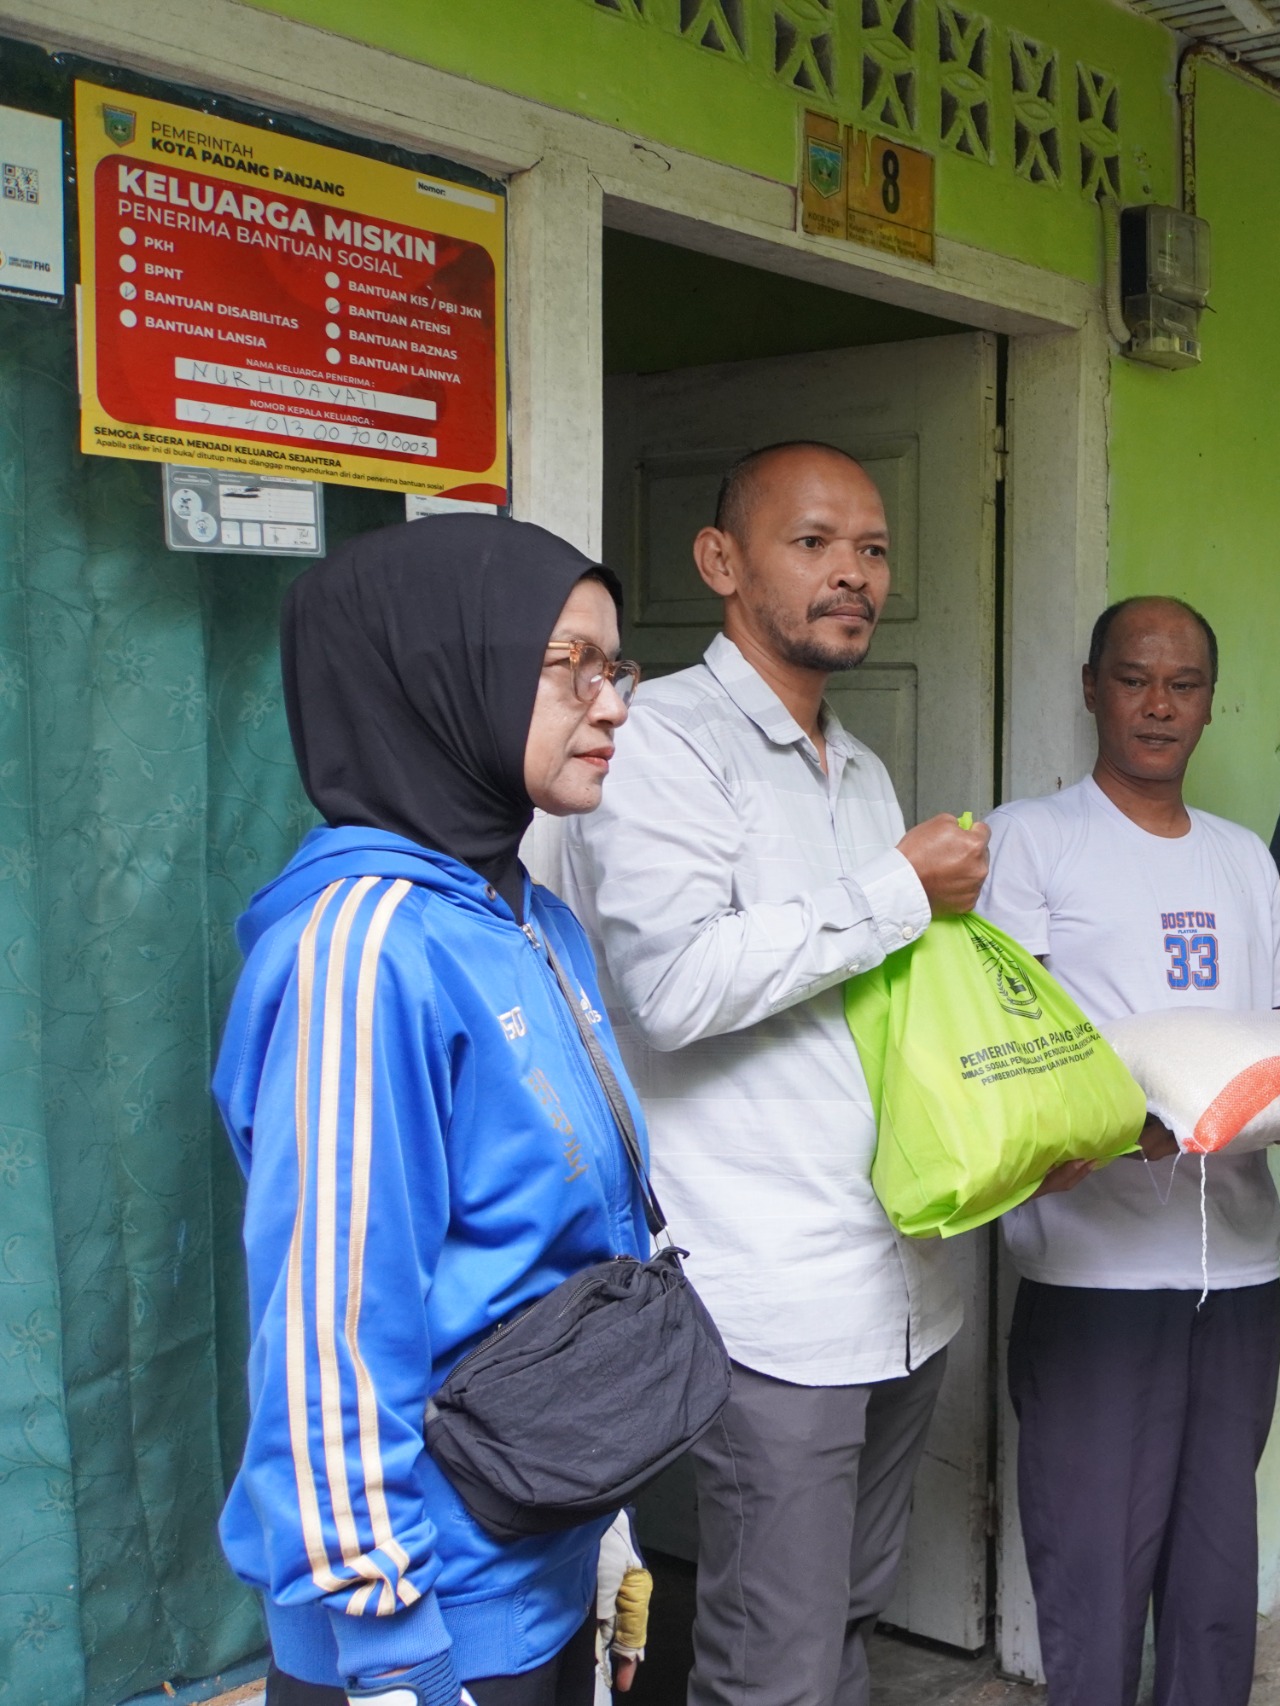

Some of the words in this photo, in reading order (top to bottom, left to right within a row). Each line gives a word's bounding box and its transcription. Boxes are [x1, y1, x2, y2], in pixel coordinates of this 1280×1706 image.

[151, 121, 253, 159] PEMERINTAH
[151, 137, 197, 160] KOTA
[201, 150, 270, 178] PADANG
[273, 168, 346, 197] PANJANG
[882, 149, 899, 214] 8
[418, 181, 446, 196] Nomor:
[118, 164, 315, 237] KELUARGA
[324, 214, 436, 265] MISKIN
[118, 199, 231, 240] PENERIMA
[236, 225, 332, 262] BANTUAN
[338, 249, 403, 279] SOSIAL
[144, 236, 174, 253] PKH
[34, 261, 51, 273] FHG
[144, 263, 183, 280] BPNT
[144, 290, 214, 313] BANTUAN
[217, 304, 299, 330] DISABILITAS
[348, 280, 407, 303] BANTUAN
[410, 294, 429, 308] KIS
[438, 301, 458, 314] PBI
[460, 307, 482, 319] JKN
[145, 316, 214, 338] BANTUAN
[217, 330, 267, 349] LANSIA
[348, 305, 407, 327] BANTUAN
[410, 318, 451, 336] ATENSI
[349, 329, 407, 351] BANTUAN
[410, 342, 458, 360] BAZNAS
[246, 358, 274, 371] NAMA
[276, 363, 324, 379] KELUARGA
[349, 354, 408, 375] BANTUAN
[411, 366, 461, 385] LAINNYA
[250, 400, 285, 412] NOMOR
[287, 405, 322, 418] KEPALA
[94, 426, 140, 441] SEMOGA
[142, 433, 184, 446] SEGERA
[186, 439, 232, 453] MENJADI
[234, 445, 287, 461] KELUARGA
[289, 454, 342, 468] SEJAHTERA
[96, 438, 127, 450] Apabila
[128, 443, 151, 452] stiker
[152, 445, 162, 454] ini
[197, 451, 225, 462] ditutup
[227, 455, 248, 464] maka
[249, 457, 283, 470] dianggap
[285, 464, 338, 477] mengundurkan
[340, 470, 350, 478] diri
[352, 472, 365, 480] dari
[366, 474, 397, 485] penerima
[399, 478, 425, 488] bantuan
[426, 482, 445, 491] sosial
[1160, 911, 1216, 930] BOSTON
[1164, 933, 1220, 990] 33
[1021, 1035, 1050, 1055] KOTA
[985, 1060, 1010, 1072] SOSIAL
